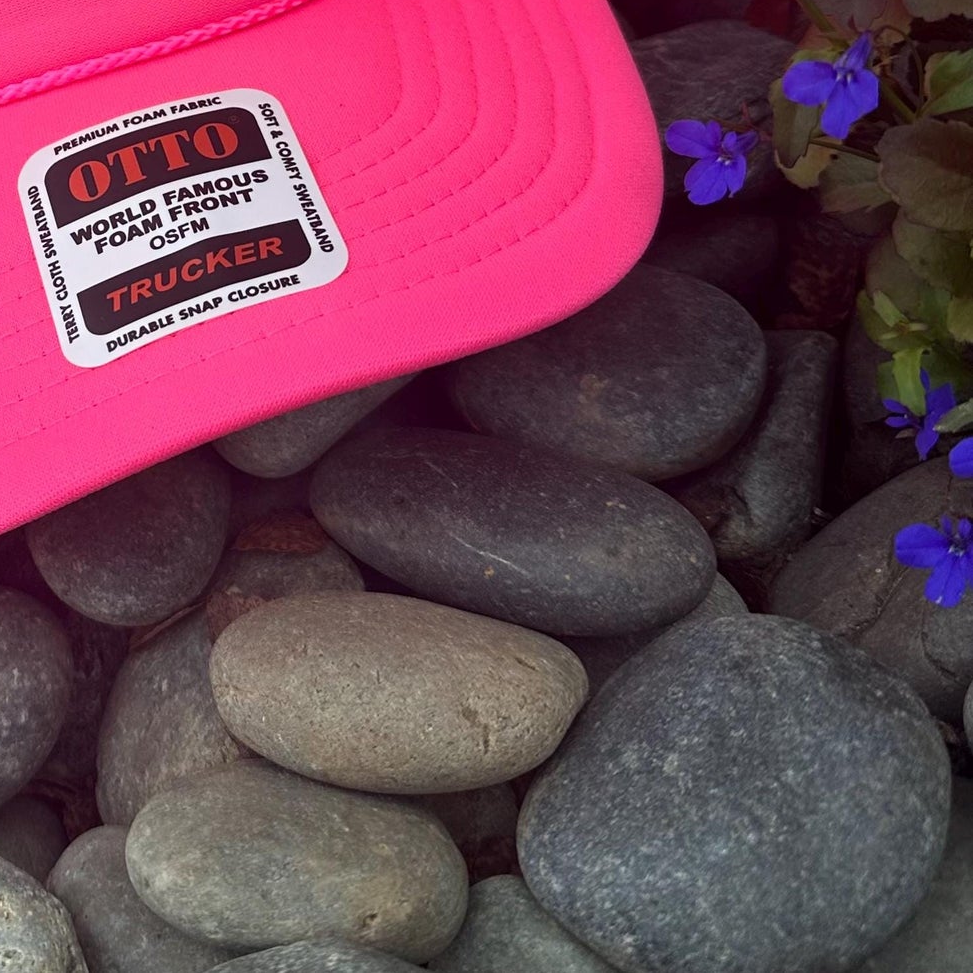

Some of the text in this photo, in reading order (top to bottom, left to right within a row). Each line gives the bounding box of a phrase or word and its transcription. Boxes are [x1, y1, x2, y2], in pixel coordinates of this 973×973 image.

[53, 96, 222, 155] PREMIUM FOAM FABRIC
[68, 122, 239, 203] OTTO
[70, 169, 269, 246] WORLD FAMOUS
[258, 102, 279, 131] SOFT
[275, 140, 302, 182] COMFY
[293, 183, 334, 253] SWEATBAND
[94, 188, 254, 255] FOAM FRONT
[149, 217, 210, 251] OSFM
[27, 185, 80, 344] TERRY CLOTH SWEATBAND
[106, 236, 284, 312] TRUCKER
[106, 274, 301, 353] DURABLE SNAP CLOSURE
